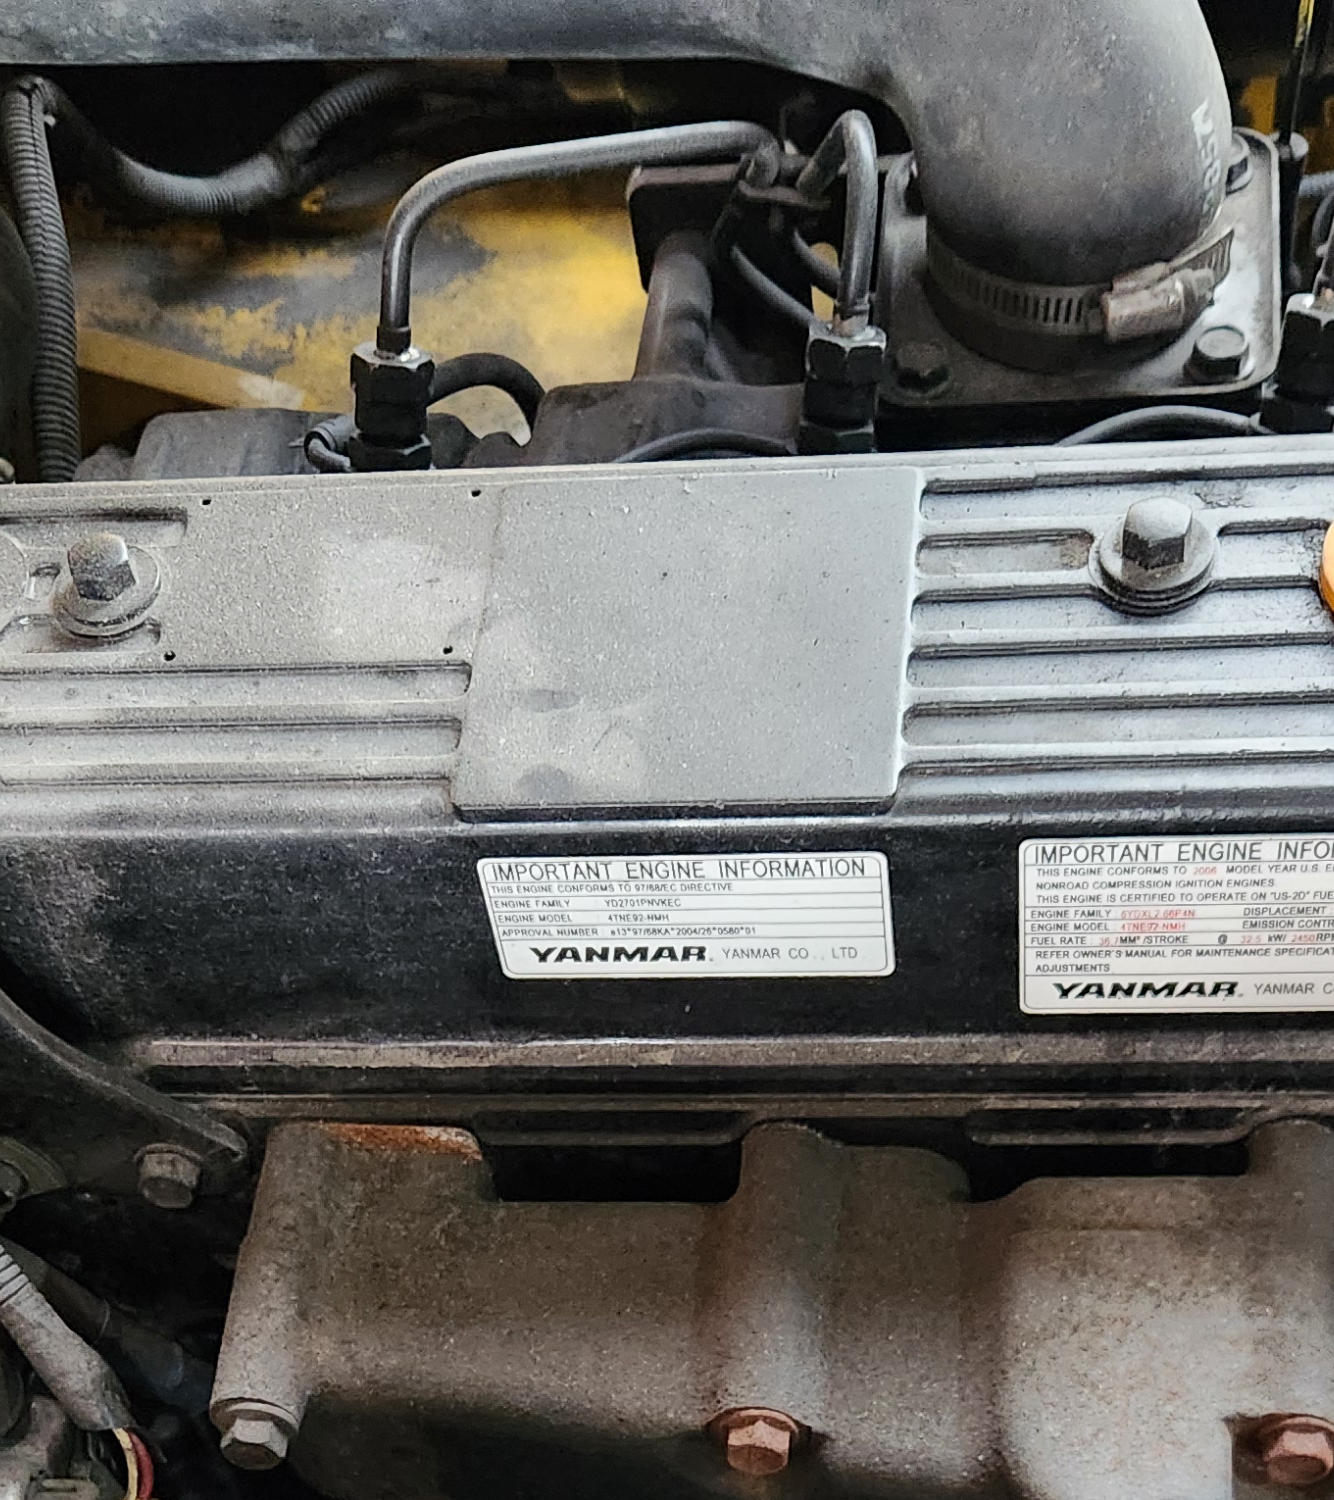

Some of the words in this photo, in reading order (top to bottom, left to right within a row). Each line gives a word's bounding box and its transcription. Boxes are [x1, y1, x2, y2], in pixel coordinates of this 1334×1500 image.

[1035, 844, 1163, 864] IMPORTANT
[1177, 841, 1262, 861] ENGINE
[492, 862, 612, 881] IMPORTANT
[626, 860, 705, 880] ENGINE
[719, 859, 865, 879] INFORMATION
[1037, 868, 1059, 876] THIS
[1064, 867, 1103, 876] ENGINE
[1107, 866, 1168, 875] CONFORMS
[1173, 866, 1187, 874] TO
[1226, 865, 1262, 873] MODEL
[1268, 864, 1296, 873] YEAR
[491, 885, 513, 893] THIS
[517, 885, 553, 893] ENGINE
[558, 884, 614, 893] CONFORMS
[618, 884, 630, 892] TO
[680, 883, 733, 892] DIRECTIVE
[1036, 882, 1089, 890] NONROAD
[1092, 880, 1171, 889] COMPRESSION
[1175, 880, 1222, 888] IGNITION
[1226, 879, 1274, 887] ENGINES
[1037, 895, 1059, 903] THIS
[1063, 894, 1102, 903] ENGINE
[1106, 894, 1115, 902] IS
[1120, 893, 1175, 902] CERTIFIED
[1180, 893, 1192, 901] TO
[1197, 891, 1247, 901] OPERATE
[1251, 892, 1266, 900] ON
[539, 914, 572, 922] MODEL
[1031, 910, 1069, 918] ENGINE
[1031, 923, 1069, 932] ENGINE
[1074, 923, 1109, 931] MODEL
[1242, 920, 1294, 929] EMISSION
[502, 929, 553, 937] APPROVAL
[557, 928, 598, 936] NUMBER
[1031, 937, 1056, 945] FUEL
[1060, 936, 1086, 945] RATE
[529, 946, 707, 963] YANMAR
[722, 947, 780, 959] YANMAR
[1036, 950, 1069, 959] REFER
[1125, 949, 1167, 958] MANUAL
[1171, 949, 1192, 957] FOR
[1195, 947, 1271, 957] MAINTENANCE
[1036, 964, 1110, 972] ADJUSTMENTS
[1053, 981, 1238, 999] YANMAR
[1254, 983, 1314, 995] YANMAR
